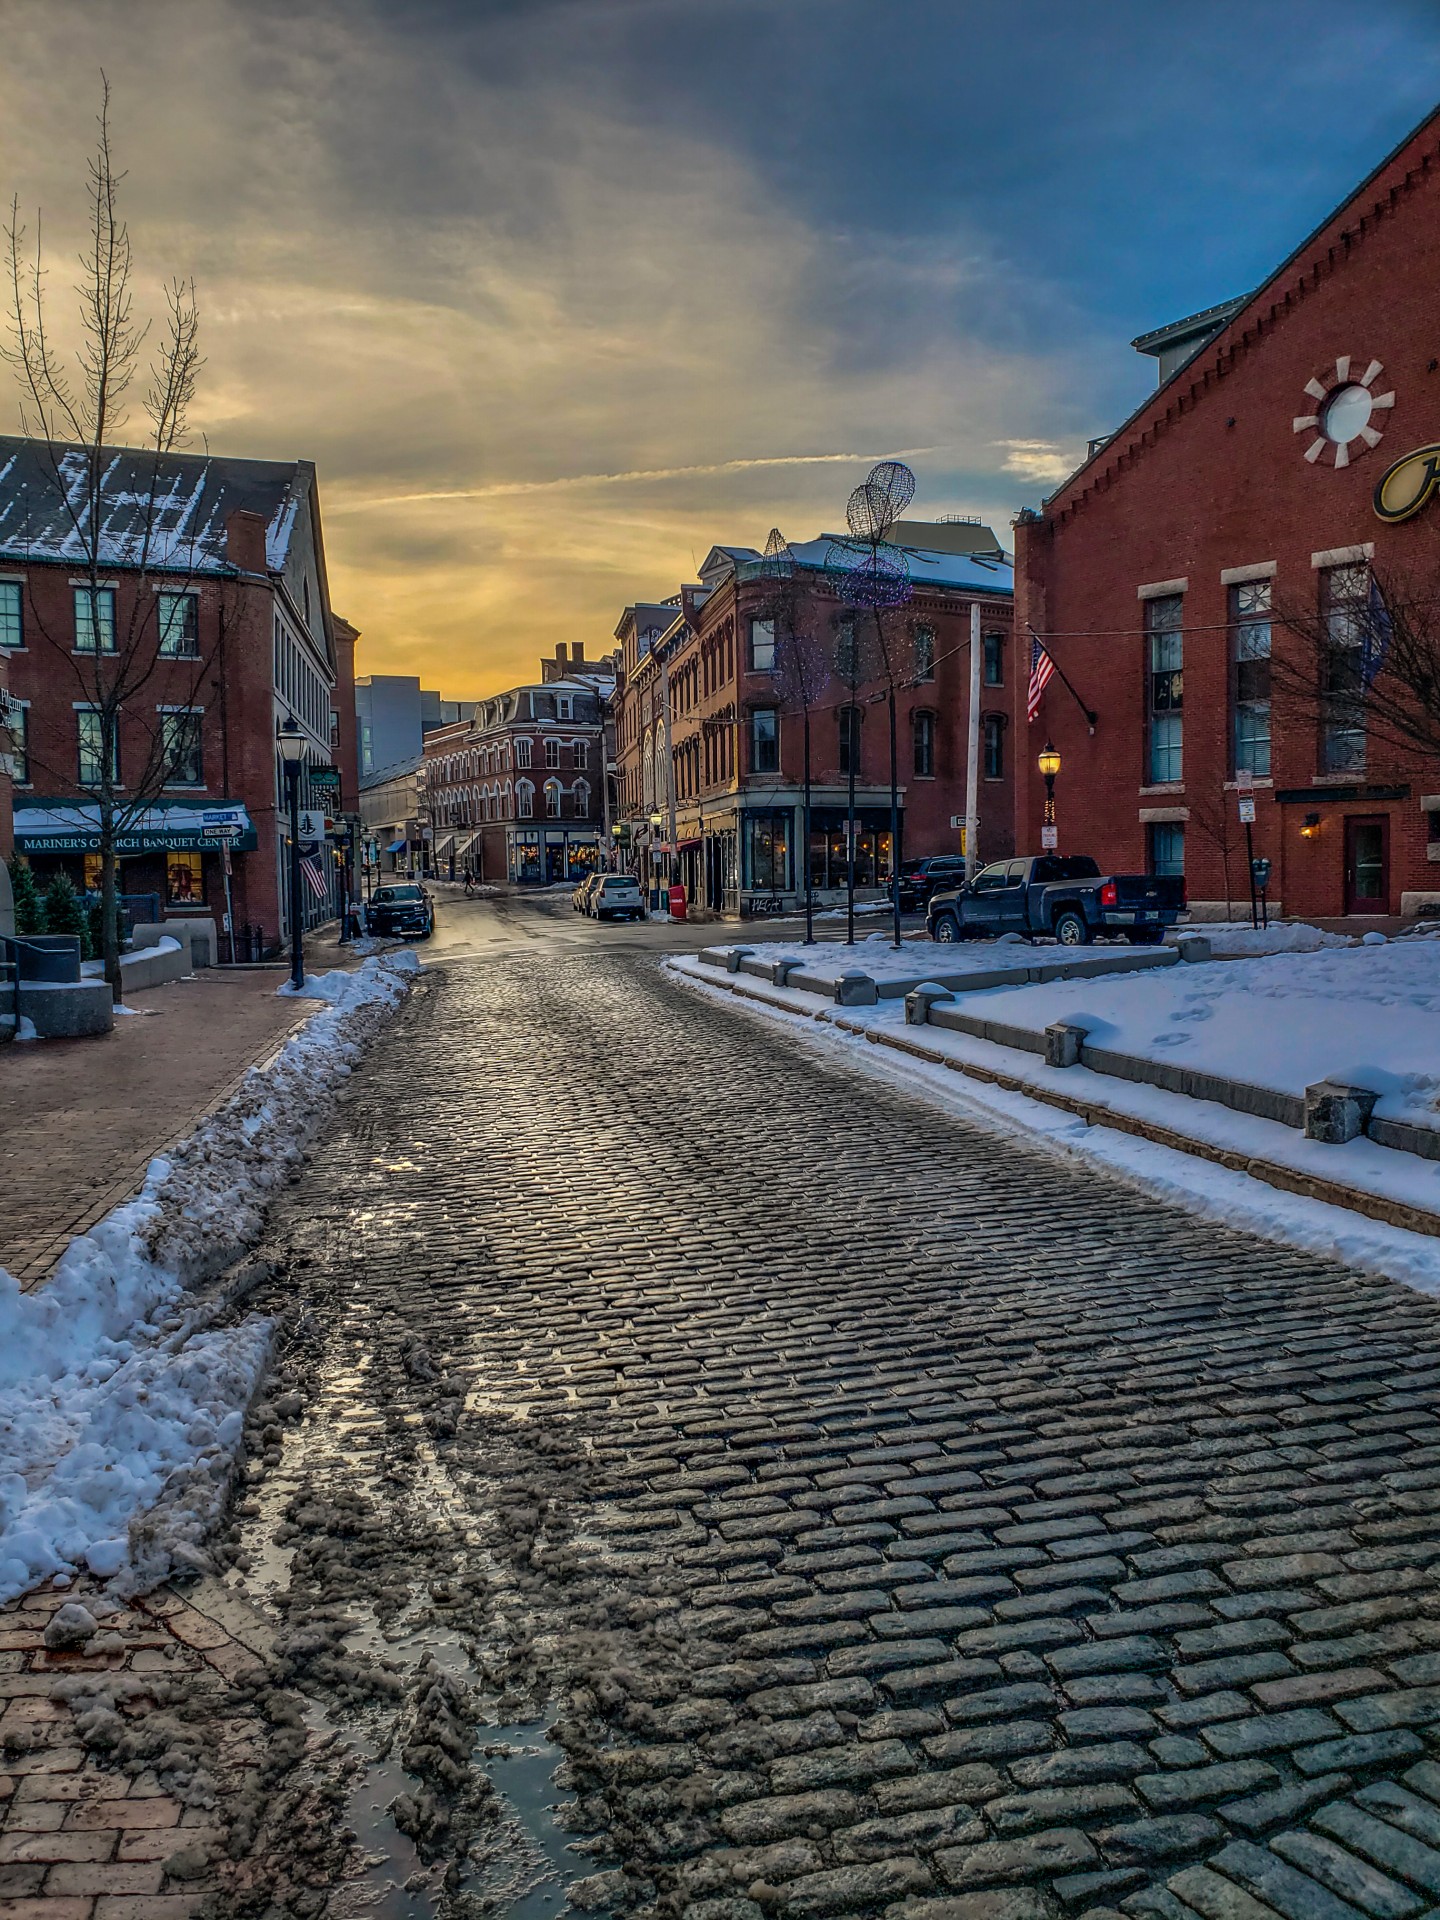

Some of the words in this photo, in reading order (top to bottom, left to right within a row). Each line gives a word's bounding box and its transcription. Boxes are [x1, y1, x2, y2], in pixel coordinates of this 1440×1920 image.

[24, 838, 87, 849] MARINER'S
[89, 838, 139, 848] CRCH
[143, 837, 195, 850] BANQUET
